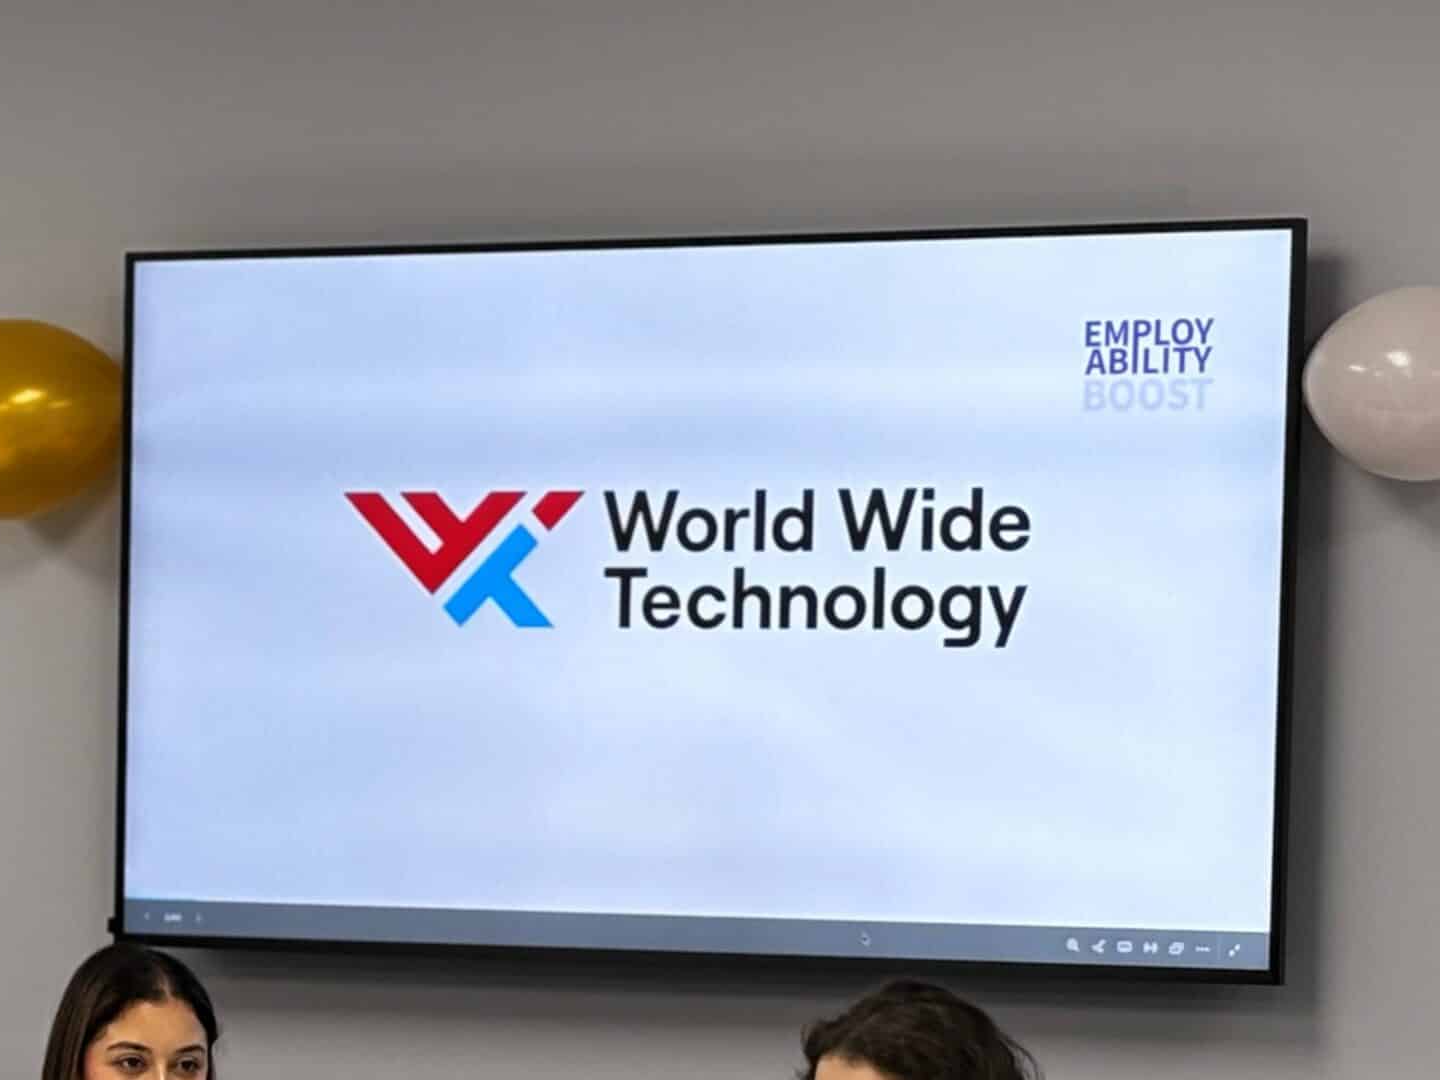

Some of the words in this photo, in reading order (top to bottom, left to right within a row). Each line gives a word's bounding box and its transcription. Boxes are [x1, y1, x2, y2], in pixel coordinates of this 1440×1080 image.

[1085, 318, 1214, 347] EMPLOY
[1085, 346, 1213, 375] ABILITY
[1083, 378, 1214, 412] BOOST
[604, 489, 814, 553] World
[838, 487, 1030, 552] Wide
[604, 566, 1027, 648] Technology
